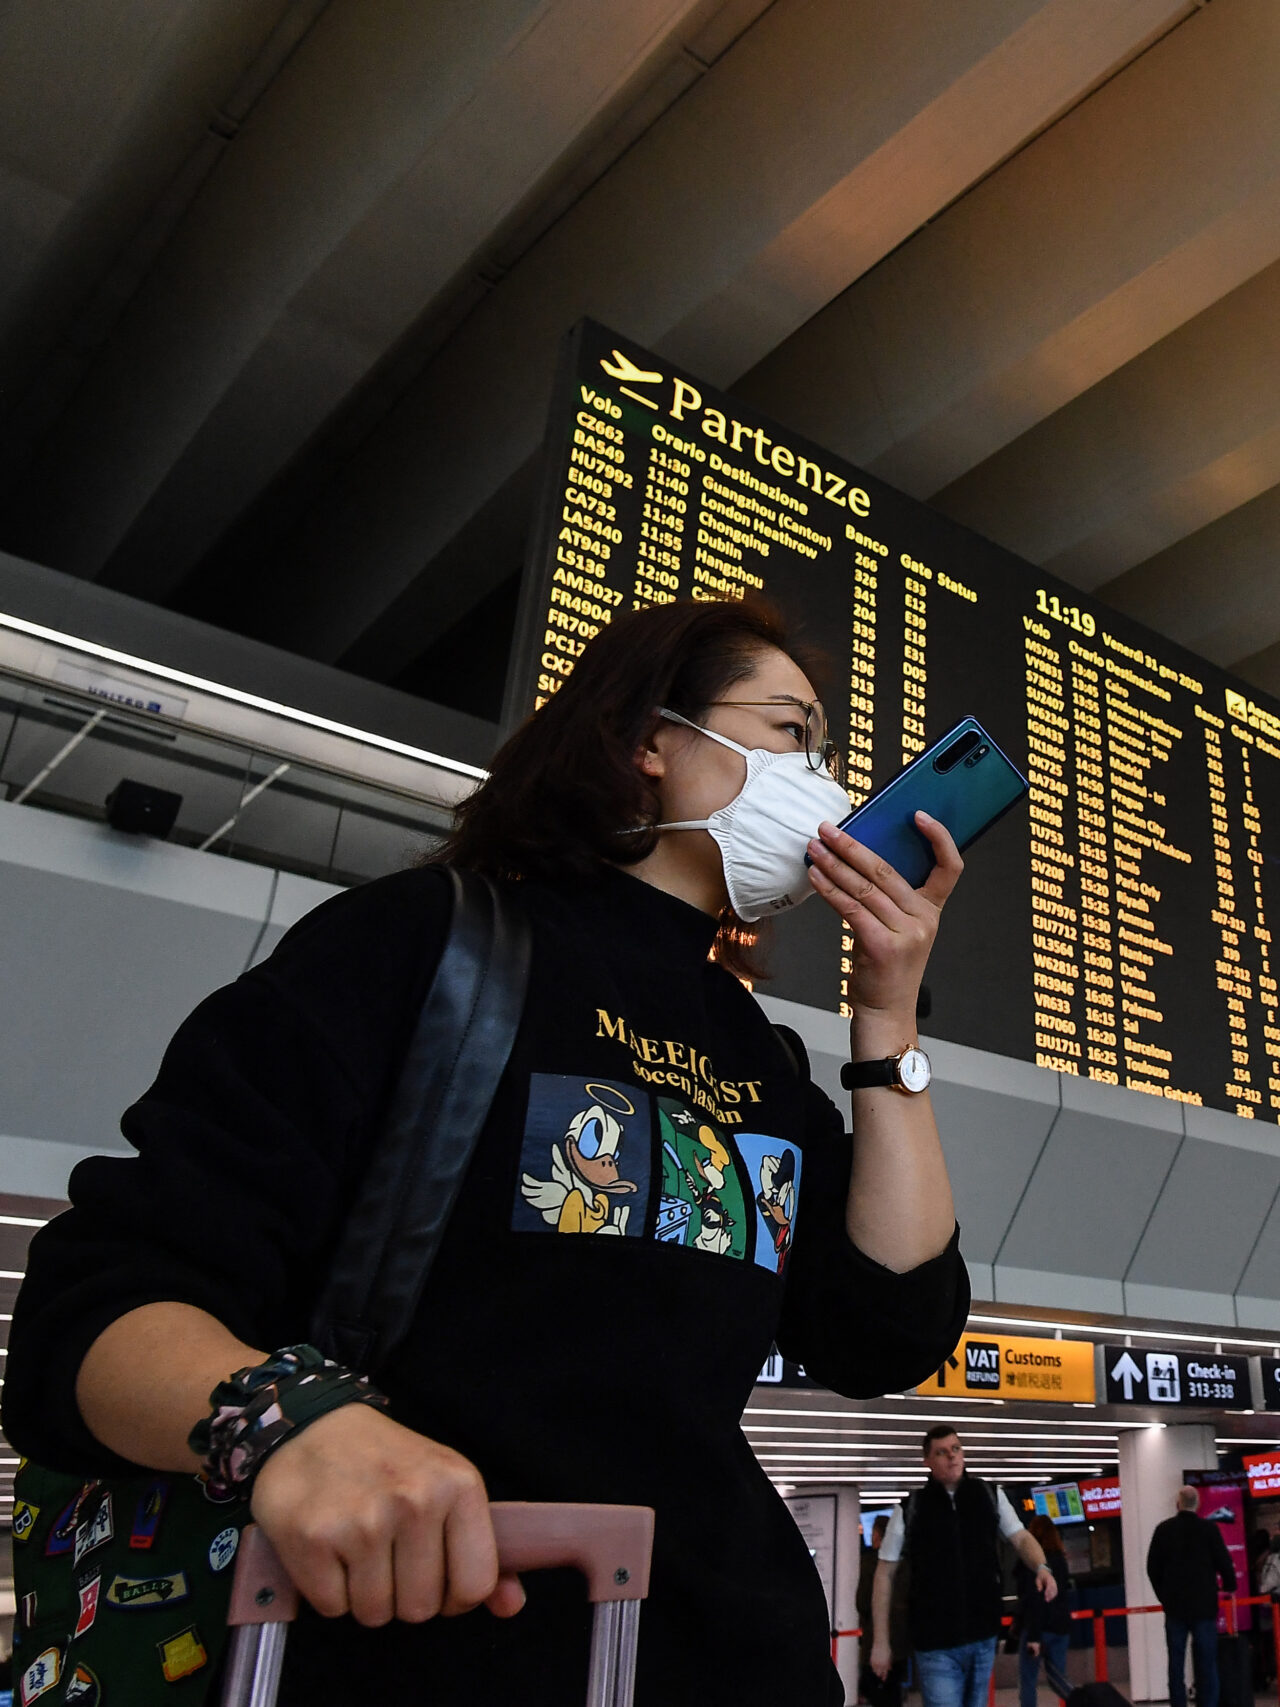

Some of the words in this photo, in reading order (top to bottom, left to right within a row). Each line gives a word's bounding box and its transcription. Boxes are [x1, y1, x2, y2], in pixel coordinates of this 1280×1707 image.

[670, 378, 870, 517] Partenze
[577, 412, 624, 445] CZ662
[650, 448, 690, 477] 11:30
[703, 476, 776, 522] Guangzhou
[778, 512, 832, 551] (Canton)
[855, 552, 877, 572] 266
[906, 577, 926, 596] E33
[581, 386, 622, 419] Volo
[652, 425, 706, 462] Orario
[709, 453, 808, 515] Destinazione
[846, 524, 888, 556] Banco
[901, 554, 932, 579] Gate
[938, 573, 977, 602] Status
[571, 448, 633, 489] HU7992
[646, 485, 686, 513] 11:40
[699, 512, 769, 556] Chongqing
[854, 586, 876, 607] 341
[905, 611, 926, 630] E39
[574, 429, 624, 463] BA549
[648, 467, 688, 495] 11:40
[701, 492, 750, 527] London
[753, 518, 817, 559] Heathrow
[855, 569, 877, 589] 326
[905, 594, 926, 614] E12
[568, 467, 612, 498] EI403
[643, 504, 684, 532] 11:45
[698, 529, 742, 560] Dublin
[854, 604, 876, 624] 204
[905, 628, 926, 647] E18
[563, 506, 622, 543] LA5440
[639, 542, 680, 570] 11:55
[694, 566, 744, 601] Madrid
[853, 639, 875, 659] 182
[903, 662, 926, 682] D05
[566, 488, 616, 521] CA732
[641, 523, 682, 551] 11:55
[696, 547, 763, 589] Hangzhou
[853, 621, 876, 641] 335
[905, 645, 925, 665] E31
[559, 527, 610, 559] AT943
[637, 561, 679, 590] 12:00
[852, 657, 875, 677] 196
[904, 680, 925, 699] E15
[1036, 590, 1095, 637] 11:19
[557, 546, 605, 578] LS136
[851, 675, 874, 695] 313
[904, 698, 925, 717] E14
[551, 587, 611, 624] FR4904
[850, 713, 874, 733] 154
[553, 568, 623, 606] AM3027
[850, 694, 874, 714] 383
[903, 716, 925, 736] E21
[1023, 616, 1050, 639] Volo
[1069, 641, 1104, 667] Orario
[1106, 659, 1171, 702] Destinazione
[548, 608, 601, 639] FR709
[849, 732, 873, 752] 154
[848, 751, 872, 771] 268
[847, 770, 872, 790] 359
[1078, 808, 1105, 828] 15:10
[1078, 825, 1106, 845] 15:10
[1030, 822, 1064, 845] TU753
[1079, 842, 1107, 862] 15:15
[1080, 860, 1108, 880] 15:20
[1081, 878, 1109, 897] 15:20
[1032, 877, 1063, 899] RJ102
[1082, 895, 1110, 915] 15:25
[1032, 896, 1077, 922] EJU7976
[1082, 914, 1111, 933] 15:30
[1033, 914, 1077, 941] EJU7712
[1083, 932, 1111, 952] 15:55
[1084, 951, 1112, 970] 16:00
[1034, 972, 1074, 996] FR3946
[1085, 988, 1114, 1008] 16:05
[1084, 969, 1113, 989] 16:00
[1034, 992, 1070, 1014] VR633
[1086, 1008, 1115, 1027] 16:15
[1036, 1032, 1082, 1057] EJU1711
[1088, 1047, 1117, 1065] 16:25
[1087, 1027, 1116, 1046] 16:20
[1036, 1053, 1079, 1077] BA2541
[1088, 1067, 1118, 1086] 16:50
[967, 1348, 999, 1369] VAT
[1005, 1349, 1062, 1367] Customs
[1187, 1362, 1236, 1381] Check-in
[967, 1371, 999, 1383] REFUND
[1189, 1381, 1235, 1399] 313-338
[123, 1582, 169, 1599] BALLY
